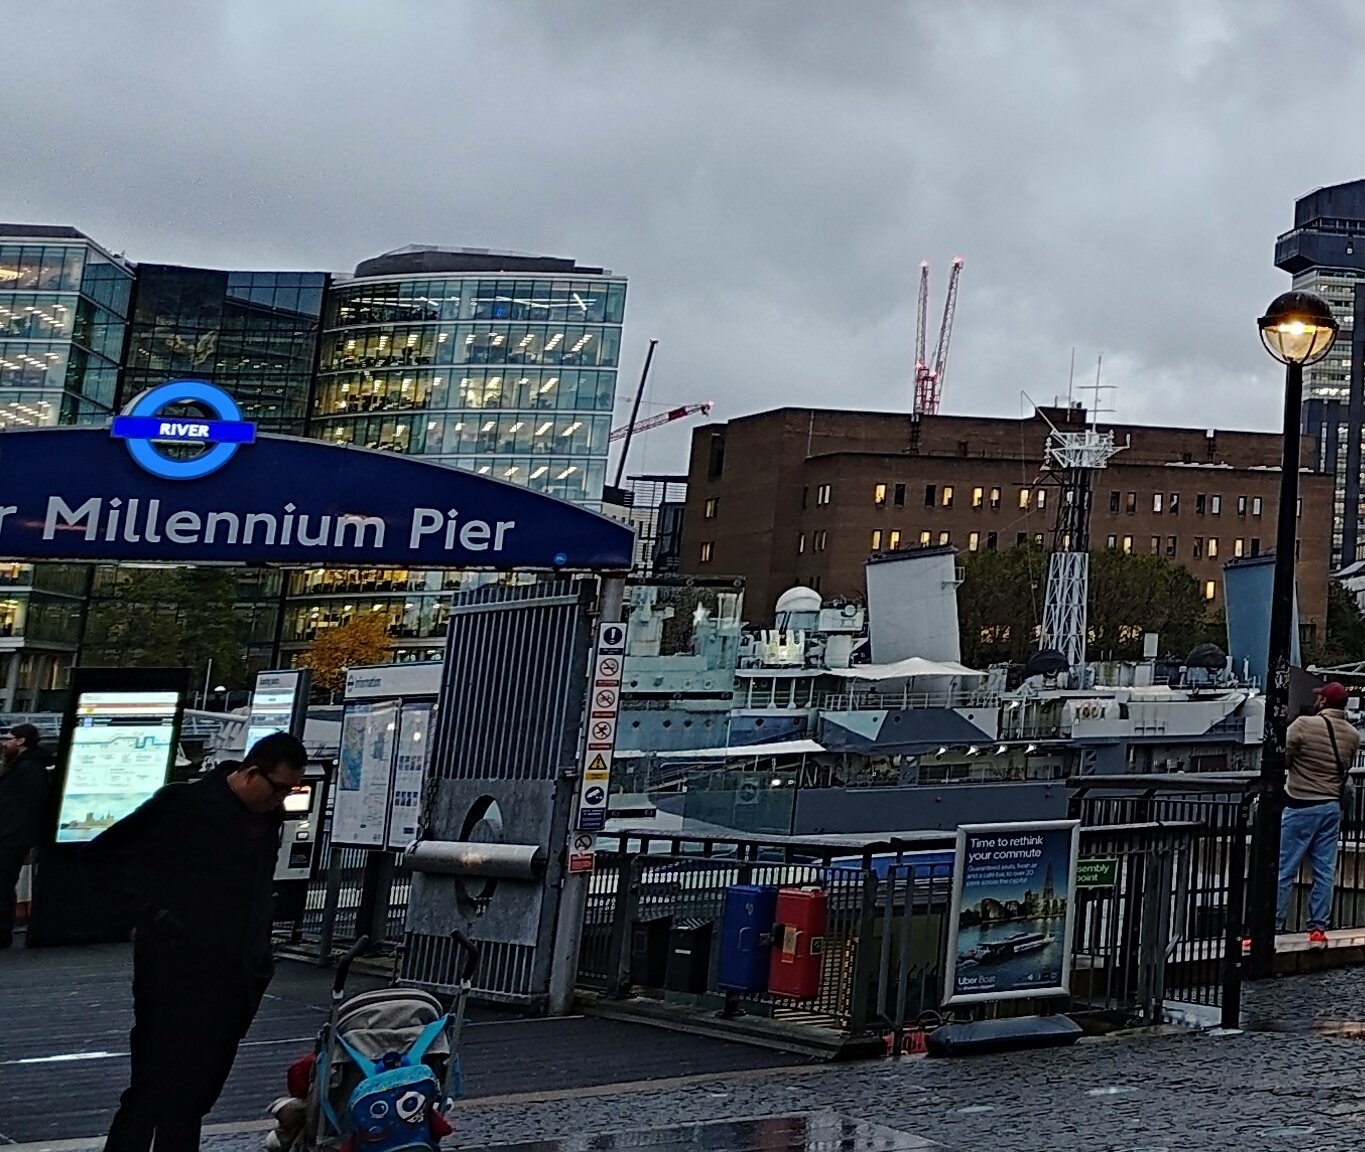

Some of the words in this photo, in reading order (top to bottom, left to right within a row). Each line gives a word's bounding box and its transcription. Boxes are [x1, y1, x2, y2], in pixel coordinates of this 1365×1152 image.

[159, 423, 209, 438] RIVER
[42, 496, 386, 548] Millennium
[410, 507, 516, 551] Pier
[970, 838, 995, 848] Time
[997, 837, 1008, 847] to
[1009, 835, 1043, 847] rethink
[968, 852, 991, 863] your
[993, 848, 1042, 860] commute
[958, 975, 978, 985] Uber
